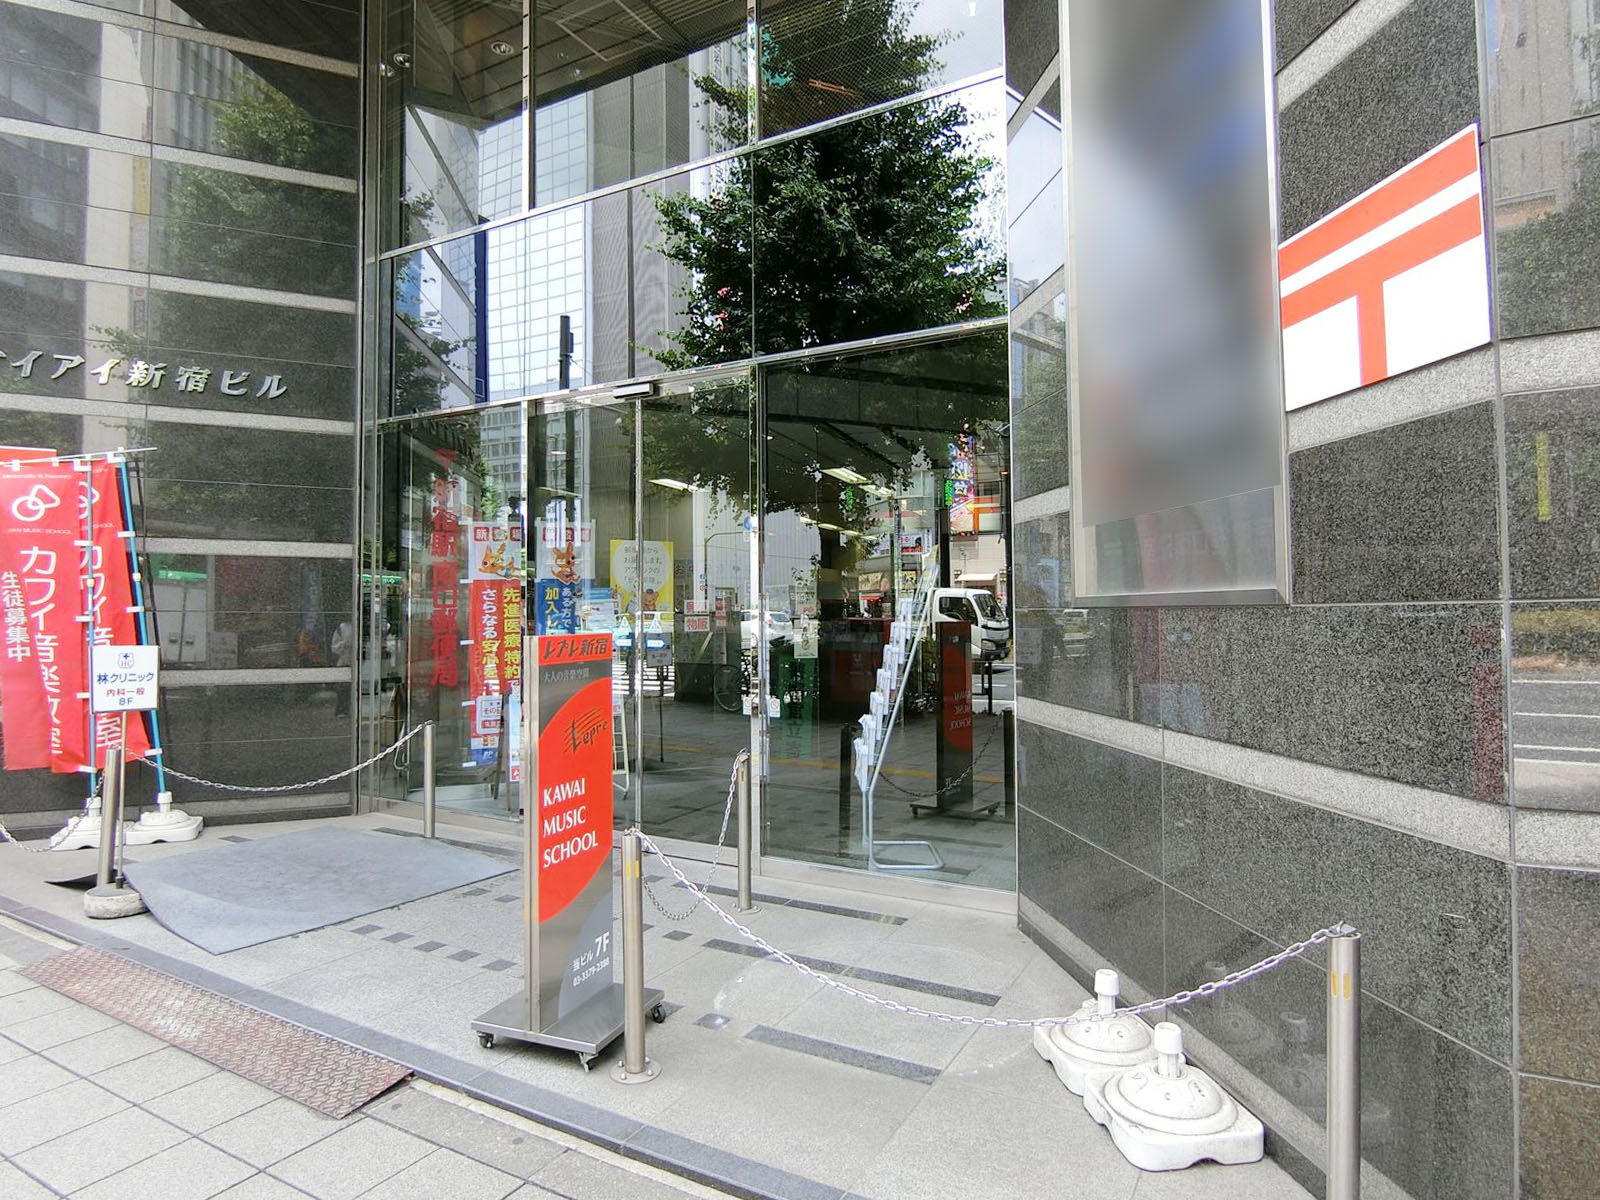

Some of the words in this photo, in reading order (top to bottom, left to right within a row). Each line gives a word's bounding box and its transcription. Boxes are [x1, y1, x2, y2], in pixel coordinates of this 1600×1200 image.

[2, 571, 31, 663] 生徒募集中
[543, 639, 609, 660] レプレ新宿
[97, 672, 155, 685] 林クリニック
[106, 687, 145, 697] 内科一般
[119, 697, 134, 706] 8F
[571, 719, 608, 753] Lepre
[543, 777, 586, 807] KAWAI
[543, 805, 586, 838] MUSIC
[543, 830, 598, 868] SCHOOL
[573, 950, 594, 972] 当ビル
[595, 931, 610, 957] 7F
